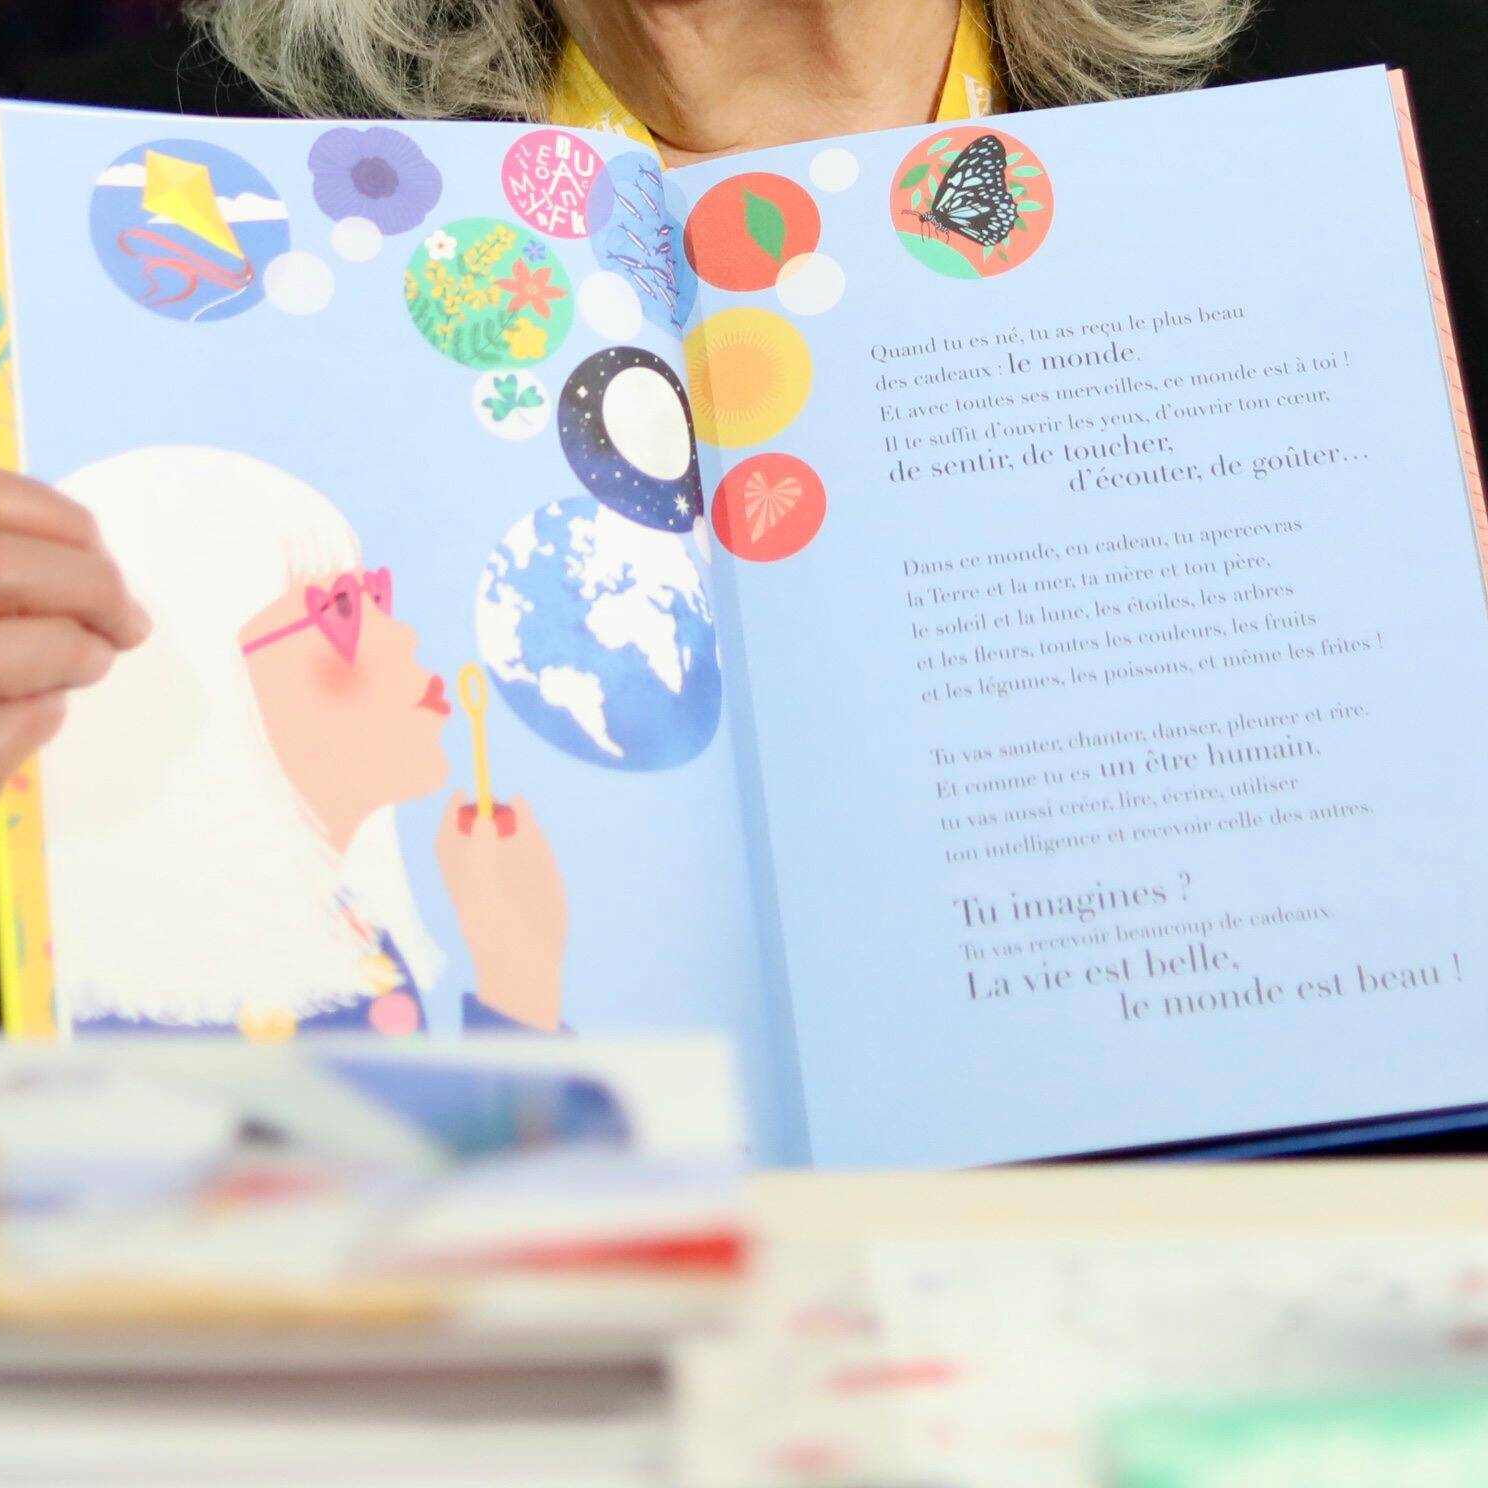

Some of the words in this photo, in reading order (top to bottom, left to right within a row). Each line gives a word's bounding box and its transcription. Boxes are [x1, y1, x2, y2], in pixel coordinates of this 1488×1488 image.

[870, 337, 936, 364] Quand
[943, 338, 963, 351] tu
[969, 336, 989, 348] es
[1029, 328, 1050, 342] tu
[1055, 326, 1075, 338] as
[1081, 322, 1123, 337] reçu
[1129, 314, 1145, 330] le
[1152, 310, 1192, 334] plus
[1197, 306, 1245, 323] beau
[875, 372, 908, 392] des
[914, 366, 991, 386] cadeaux
[1008, 352, 1031, 374] le
[881, 405, 901, 422] Et
[908, 403, 948, 418] avec
[955, 395, 1014, 412] toutes
[1021, 391, 1050, 404] ses
[1163, 377, 1183, 389] ce
[1190, 363, 1257, 386] monde
[1263, 361, 1289, 377] est
[1296, 357, 1307, 373] à
[1312, 353, 1337, 371] toi
[885, 435, 898, 453] Il
[905, 437, 922, 450] te
[929, 426, 977, 446] suffit
[985, 416, 1062, 439] d'ouvrir
[1068, 414, 1094, 430] les
[1155, 398, 1232, 420] d'ouvrir
[1238, 398, 1270, 411] ton
[888, 459, 921, 483] de
[1022, 443, 1054, 467] de
[1210, 454, 1242, 477] de
[903, 559, 954, 577] Dans
[959, 556, 980, 568] ce
[1065, 544, 1089, 557] en
[1174, 531, 1193, 545] tu
[1200, 520, 1302, 547] apercevras
[907, 591, 924, 607] la
[927, 587, 980, 604] Terre
[986, 583, 1004, 597] et
[1010, 578, 1028, 594] la
[1080, 573, 1099, 586] ta
[1105, 565, 1153, 583] mère
[1160, 563, 1176, 578] et
[1184, 562, 1217, 576] ton
[912, 622, 929, 639] le
[935, 613, 986, 636] soleil
[993, 614, 1010, 628] et
[1017, 608, 1035, 625] la
[1095, 600, 1121, 617] les
[1200, 589, 1227, 606] les
[1233, 583, 1294, 602] arbres
[917, 656, 933, 671] et
[941, 650, 968, 667] les
[1039, 638, 1100, 655] toutes
[1105, 631, 1132, 648] les
[1232, 617, 1258, 634] les
[1265, 610, 1317, 630] fruits
[921, 687, 939, 702] et
[945, 683, 973, 700] les
[1070, 666, 1097, 684] les
[1198, 655, 1215, 670] et
[1223, 649, 1282, 667] même
[1287, 643, 1315, 660] les
[1321, 637, 1371, 656] frites
[929, 748, 956, 766] Tu
[962, 748, 993, 762] vas
[1226, 713, 1299, 739] pleurer
[1304, 708, 1322, 723] et
[935, 780, 959, 799] Et
[965, 775, 1037, 795] comme
[1043, 771, 1063, 784] tu
[1070, 769, 1091, 781] es
[1100, 760, 1136, 778] un
[1145, 749, 1197, 773] être
[953, 895, 999, 928] Tu
[1011, 881, 1168, 923] imagines
[966, 969, 1013, 1000] La
[1022, 960, 1072, 993] vie
[1084, 957, 1132, 985] est
[1119, 990, 1150, 1022] le
[1163, 976, 1284, 1017] monde
[1296, 972, 1344, 1000] est
[1355, 963, 1440, 993] beau
